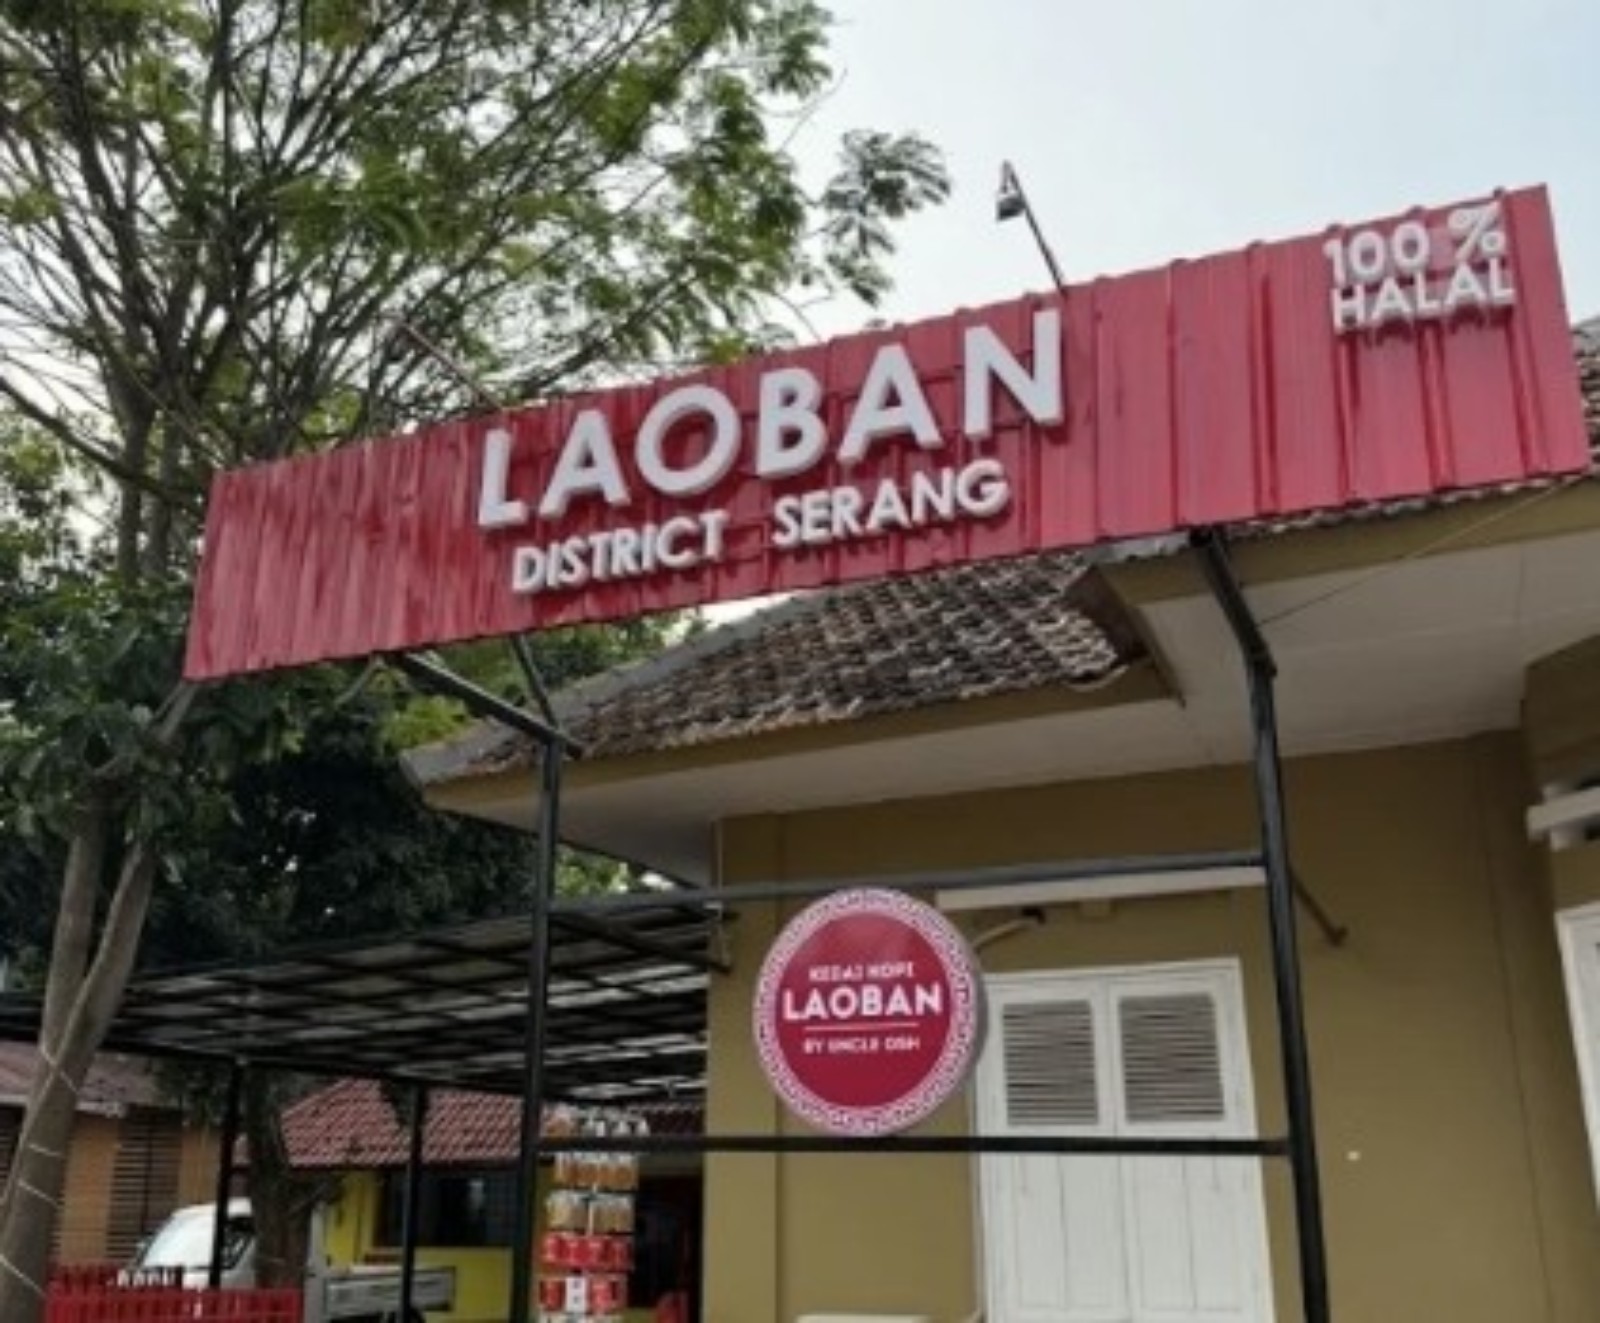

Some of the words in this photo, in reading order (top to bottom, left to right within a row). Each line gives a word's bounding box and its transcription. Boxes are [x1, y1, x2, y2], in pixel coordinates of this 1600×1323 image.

[1323, 222, 1429, 284] 100
[1448, 202, 1505, 260] %
[1332, 259, 1514, 333] HALAL
[478, 309, 1062, 527] LAOBAN
[512, 510, 727, 594] DISTRICT
[772, 459, 1009, 549] SERANG
[784, 983, 942, 1021] LAOBAN
[866, 961, 915, 979] KOPI
[804, 1038, 822, 1054] BY
[828, 1037, 879, 1053] UNCLE
